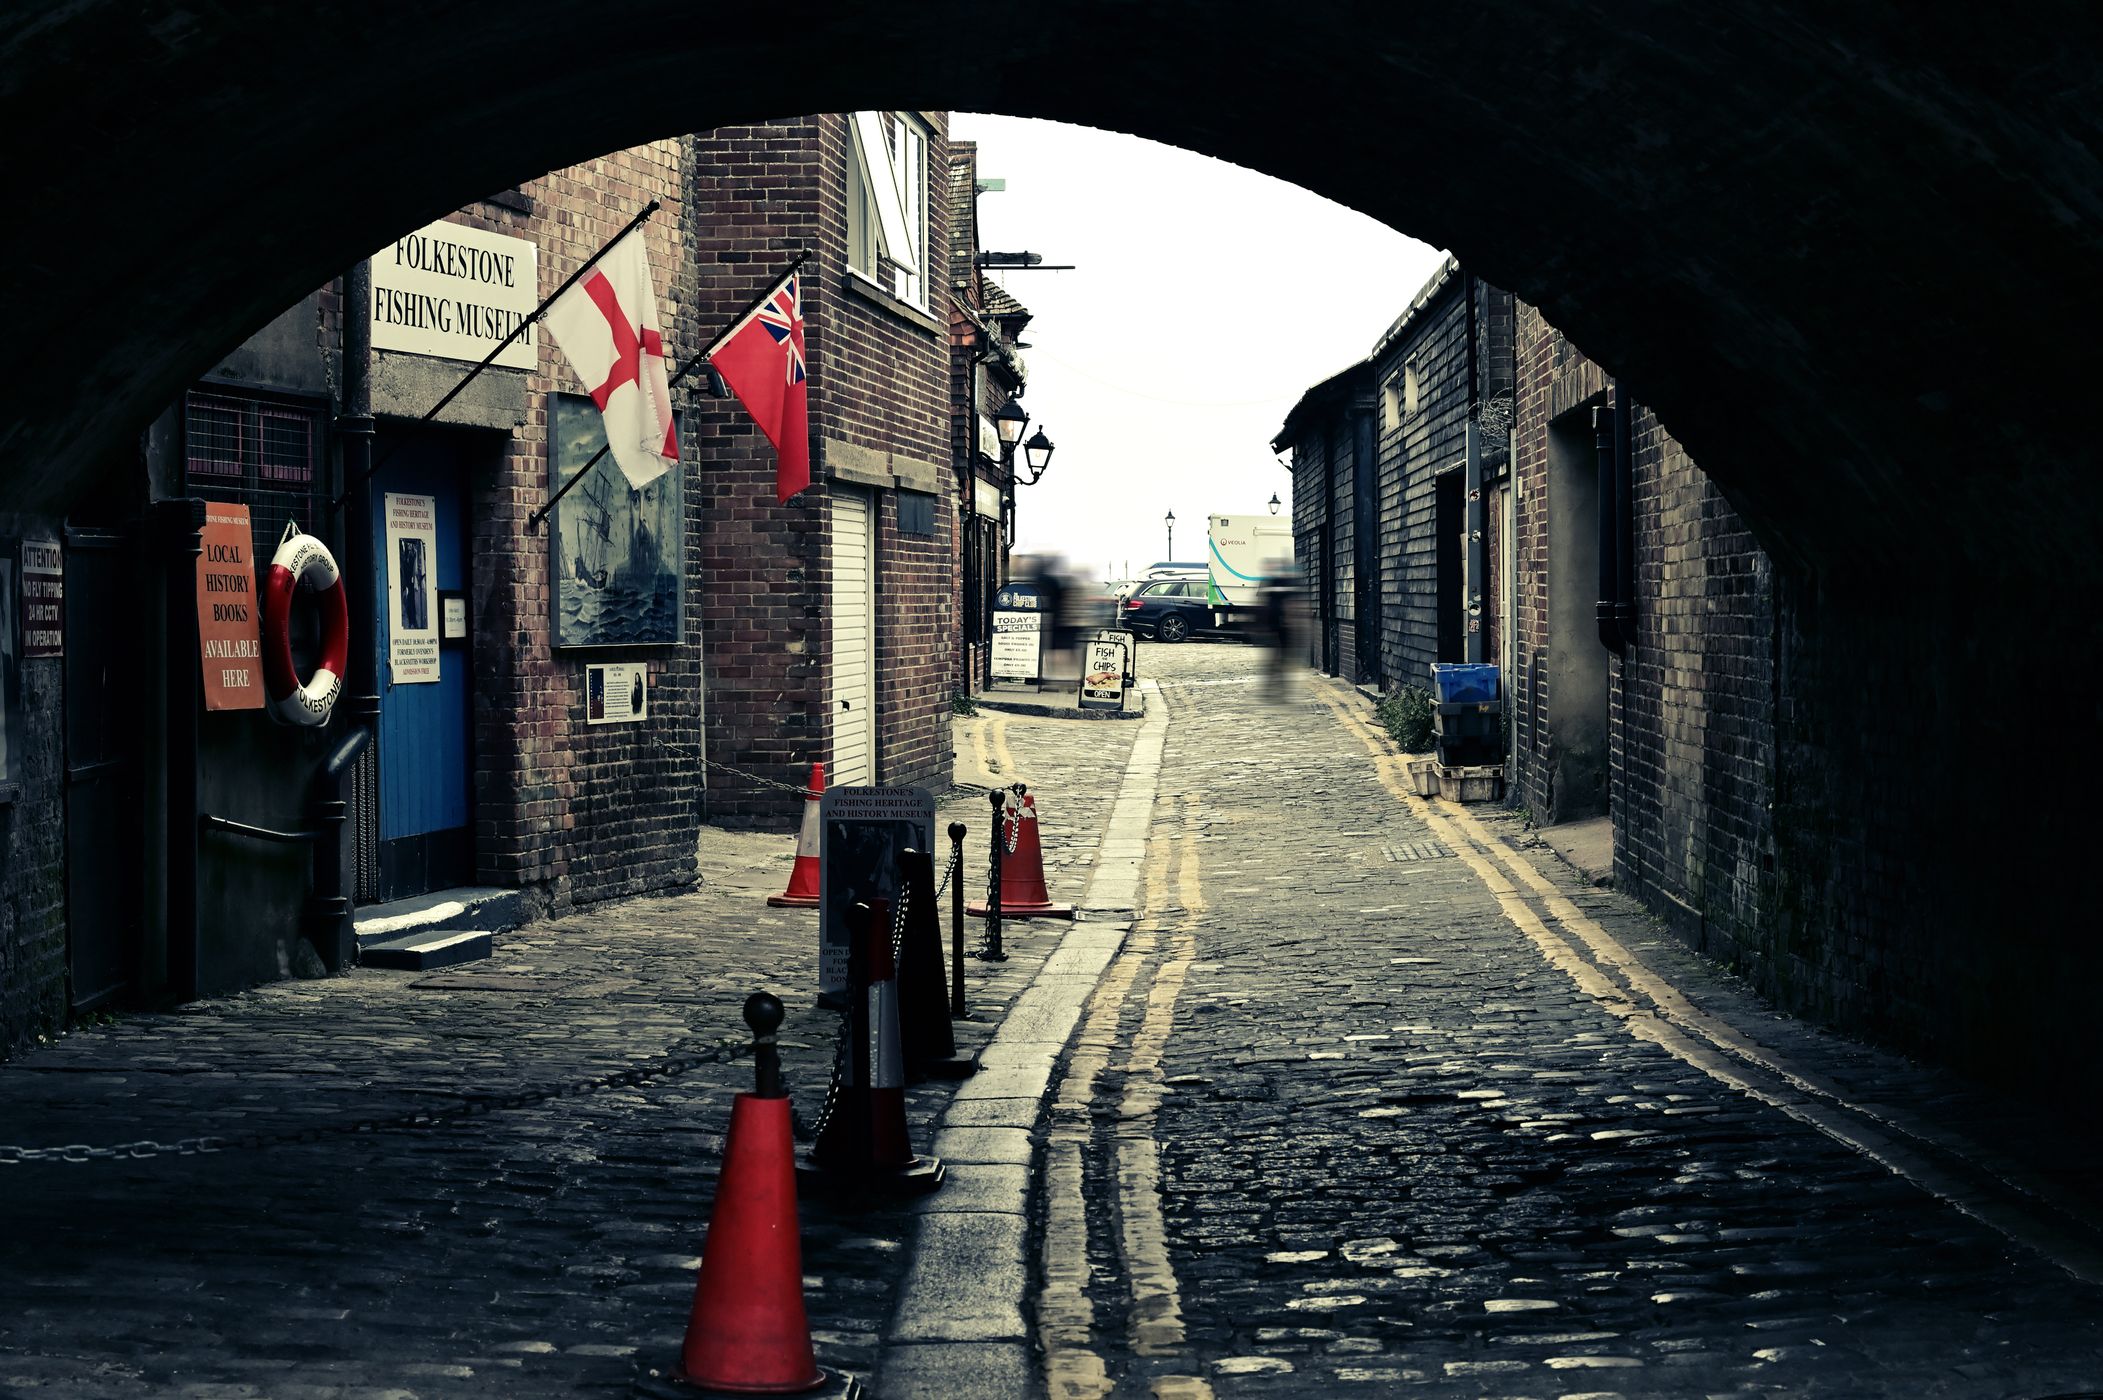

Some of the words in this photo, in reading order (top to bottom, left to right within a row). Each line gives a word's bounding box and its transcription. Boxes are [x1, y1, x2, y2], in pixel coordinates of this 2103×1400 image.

[395, 234, 515, 288] FOLKESTONE
[374, 286, 452, 334] FISHING
[456, 301, 531, 346] MUSEUM
[399, 521, 415, 530] HISTORY
[415, 522, 433, 531] MUSEUM
[23, 546, 62, 569] ATTENTION
[207, 544, 242, 564] LOCAL
[318, 554, 335, 573] GROUP
[23, 581, 31, 597] NO
[32, 581, 42, 598] FLY
[43, 581, 63, 599] TIPPING
[206, 573, 249, 593] HISTORY
[28, 604, 36, 621] 24
[36, 605, 44, 621] HR
[44, 604, 59, 621] CCTV
[213, 603, 248, 622] BOOKS
[997, 616, 1038, 624] TODAY'S
[997, 624, 1038, 632] SPECIALS
[25, 630, 31, 647] IN
[32, 630, 62, 647] OPERATION
[1109, 634, 1125, 643] FISH
[205, 639, 260, 659] AVAILABLE
[1096, 647, 1115, 657] FISH
[1093, 661, 1117, 672] CHIPS
[222, 669, 250, 688] HERE
[295, 676, 342, 713] FOLKESTONE
[1094, 690, 1111, 698] OPEN
[843, 788, 914, 797] FOLKESTONE'S
[834, 798, 873, 808] FISHING
[875, 799, 923, 808] HERITAGE
[825, 810, 845, 818] AND
[847, 810, 889, 818] HISTORY
[890, 810, 932, 818] MUSEUM
